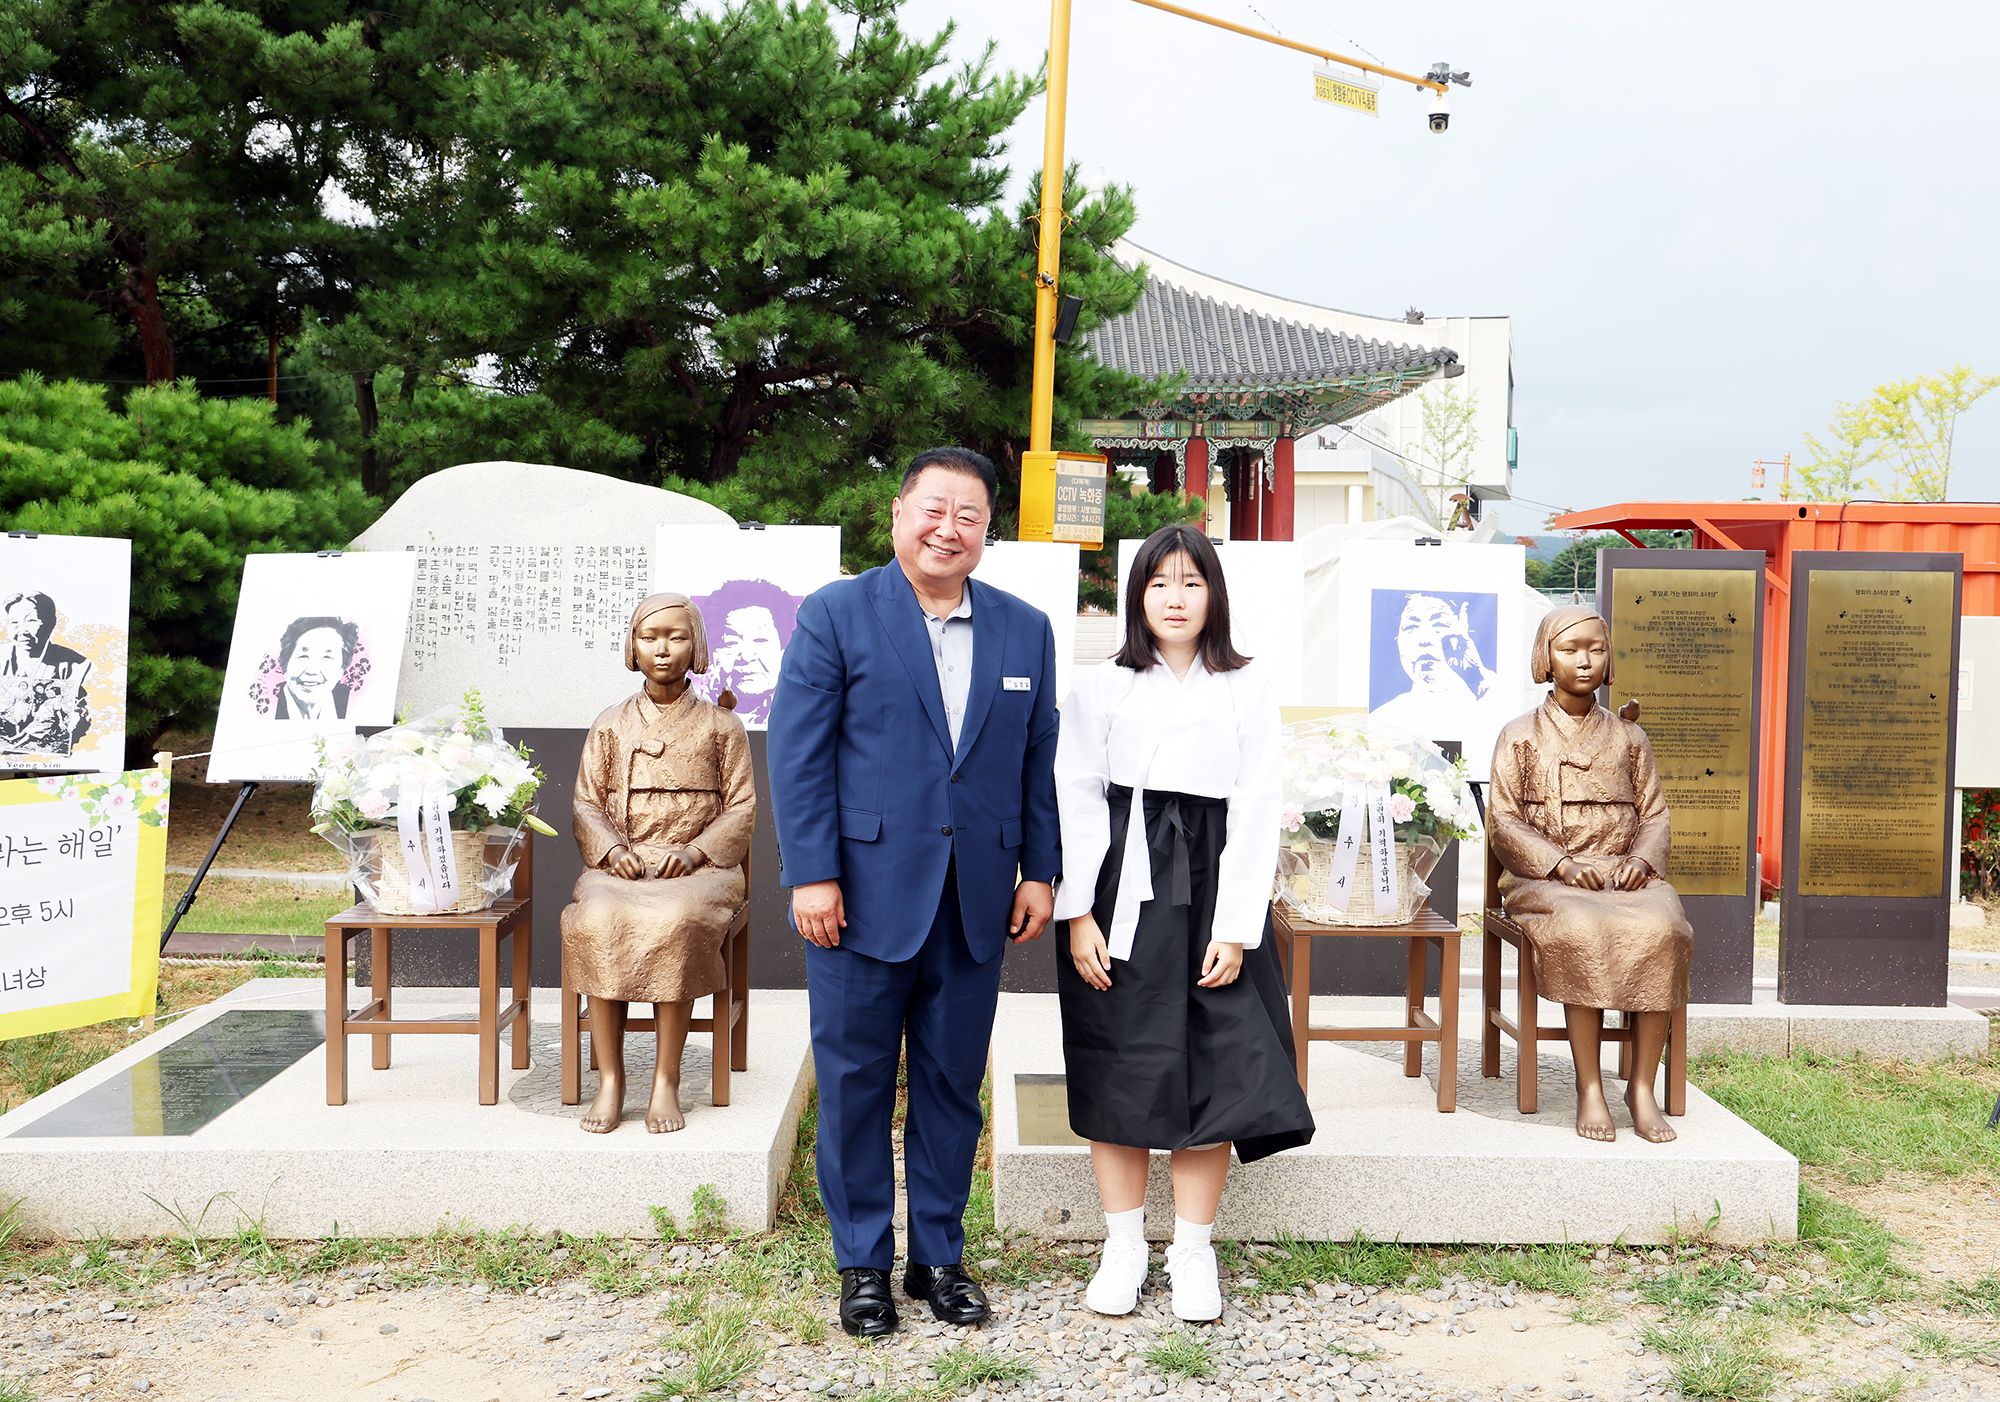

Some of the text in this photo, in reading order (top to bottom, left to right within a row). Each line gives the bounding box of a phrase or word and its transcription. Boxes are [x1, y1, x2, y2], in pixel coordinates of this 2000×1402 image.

[1315, 86, 1330, 99] 1053
[1057, 486, 1103, 505] CCTV 녹화중
[489, 546, 499, 568] 고향
[574, 546, 584, 568] 고향
[499, 585, 511, 628] 사랑하는
[525, 585, 537, 633] 산하에서
[1669, 590, 1681, 598] 가는
[453, 590, 464, 635] 임진강아
[572, 603, 582, 637] 보인다
[584, 619, 595, 649] 사이로
[498, 633, 510, 667] 사람과
[434, 826, 451, 890] 기억하겠습니다
[1378, 829, 1390, 894] 기억하겠습니다
[40, 898, 74, 922] 5시
[0, 965, 47, 993] 녀상
